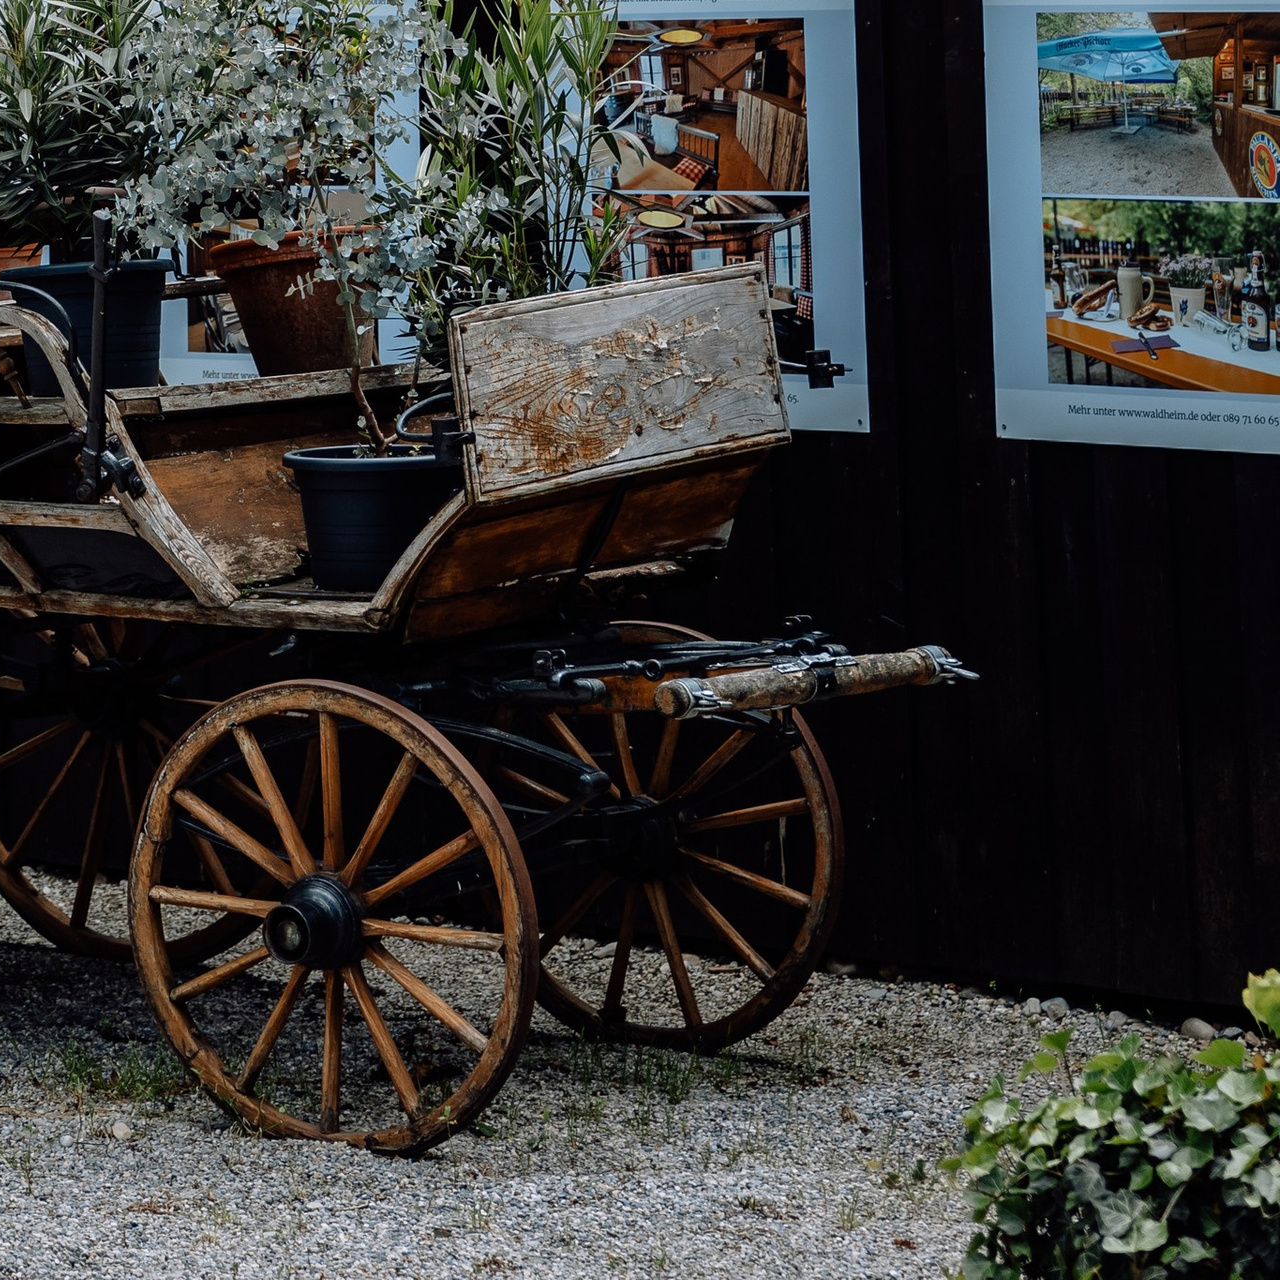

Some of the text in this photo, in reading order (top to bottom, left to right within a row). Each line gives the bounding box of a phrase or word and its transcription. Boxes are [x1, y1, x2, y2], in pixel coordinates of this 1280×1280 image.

[202, 370, 220, 379] Mehr
[1068, 404, 1091, 415] Mehr
[1093, 407, 1116, 417] unter
[1118, 408, 1199, 421] www.waldheim.de
[1200, 411, 1221, 422] oder
[1222, 413, 1240, 424] 089
[1242, 415, 1252, 425] 71
[1253, 414, 1266, 424] 60
